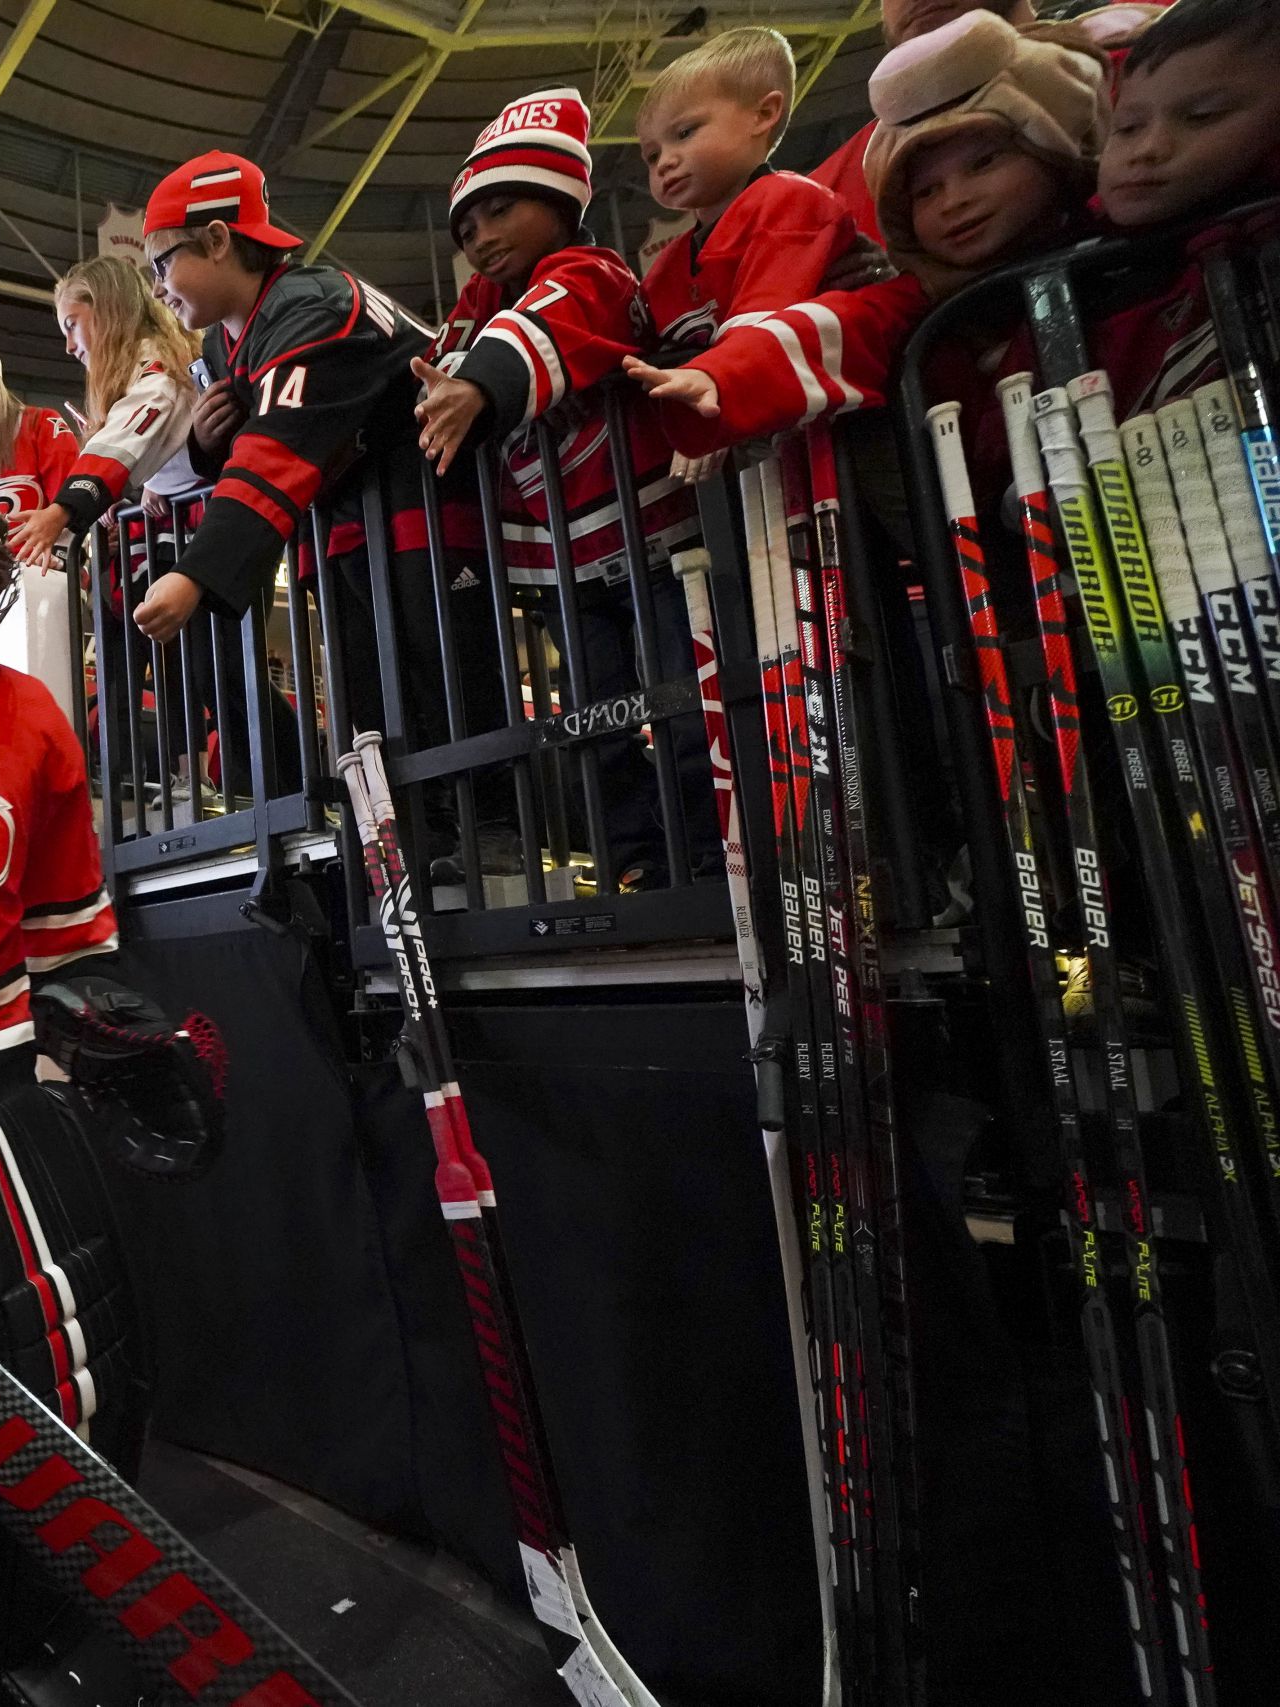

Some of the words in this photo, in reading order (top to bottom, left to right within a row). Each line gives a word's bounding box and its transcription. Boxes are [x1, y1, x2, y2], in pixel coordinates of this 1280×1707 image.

[258, 365, 308, 417] 14
[451, 577, 481, 591] adidas
[1210, 592, 1258, 696] CCM
[843, 746, 862, 811] EDMUNDSON
[1125, 747, 1148, 790] FOEGELE
[1170, 738, 1194, 783] FOEGELE
[1215, 765, 1237, 811] DZINGEL
[735, 905, 750, 939] REIMER
[783, 881, 804, 965] BAUER
[804, 876, 826, 962] BAUER
[1016, 852, 1050, 949] BAUER
[1076, 847, 1110, 949] BAUER
[396, 951, 422, 1021] PRO+
[413, 938, 438, 1009] PRO+
[797, 1042, 811, 1080] FLEURY
[821, 1042, 835, 1080] FLEURY
[1050, 1049, 1070, 1087] STAAL
[1108, 1052, 1128, 1091] STAAL
[810, 1202, 822, 1252] FLYLITE
[833, 1203, 845, 1253] FLYLITE
[1082, 1230, 1098, 1288] FLYLITE
[1136, 1241, 1151, 1301] FLYLITE
